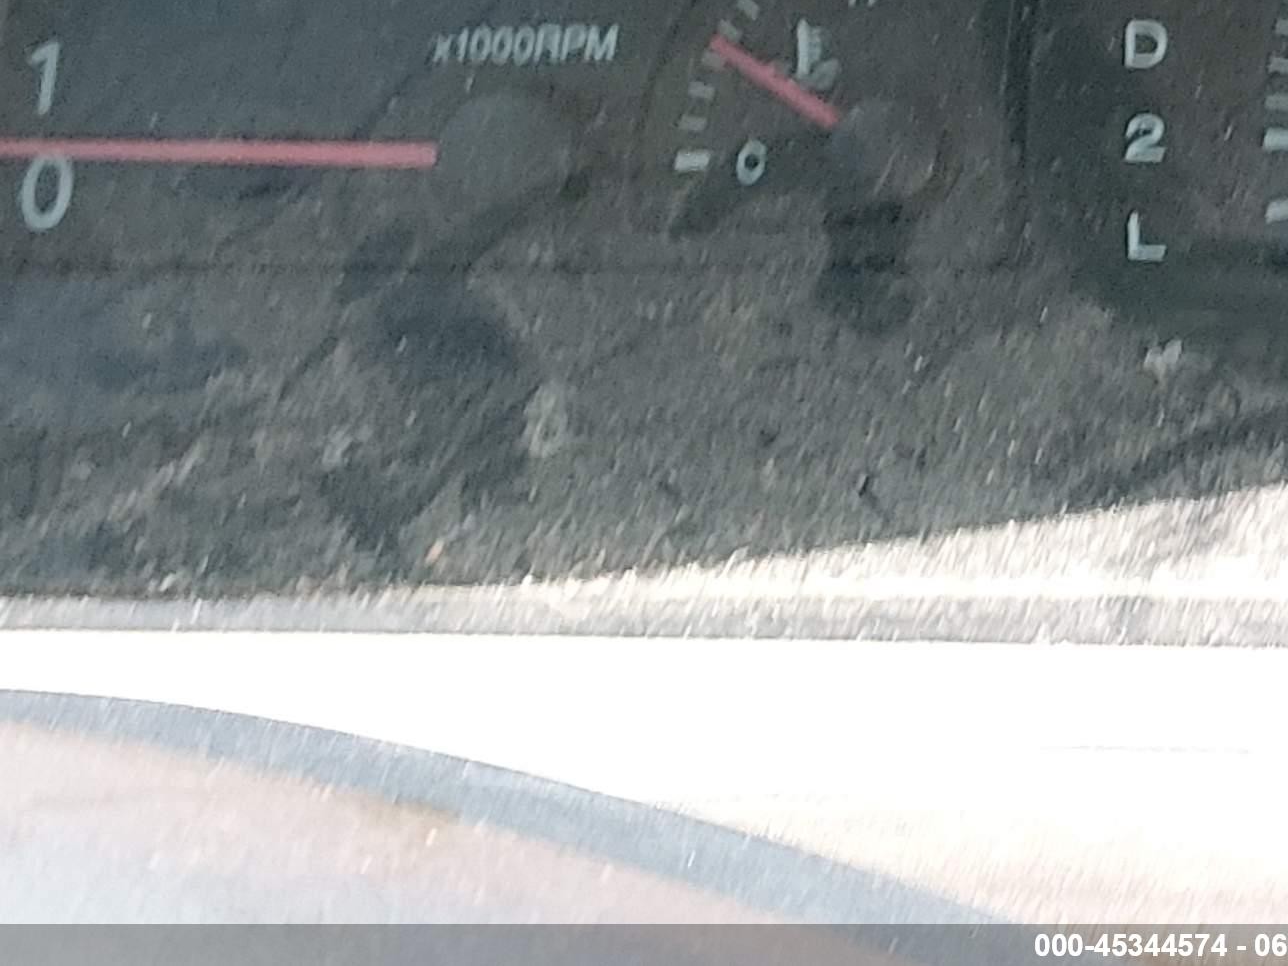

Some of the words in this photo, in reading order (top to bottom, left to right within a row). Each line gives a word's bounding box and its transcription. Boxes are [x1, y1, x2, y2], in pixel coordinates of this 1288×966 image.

[1125, 22, 1167, 69] D
[30, 41, 61, 115] 1
[1125, 113, 1167, 162] 2
[20, 152, 74, 231] 0
[1127, 211, 1167, 261] L
